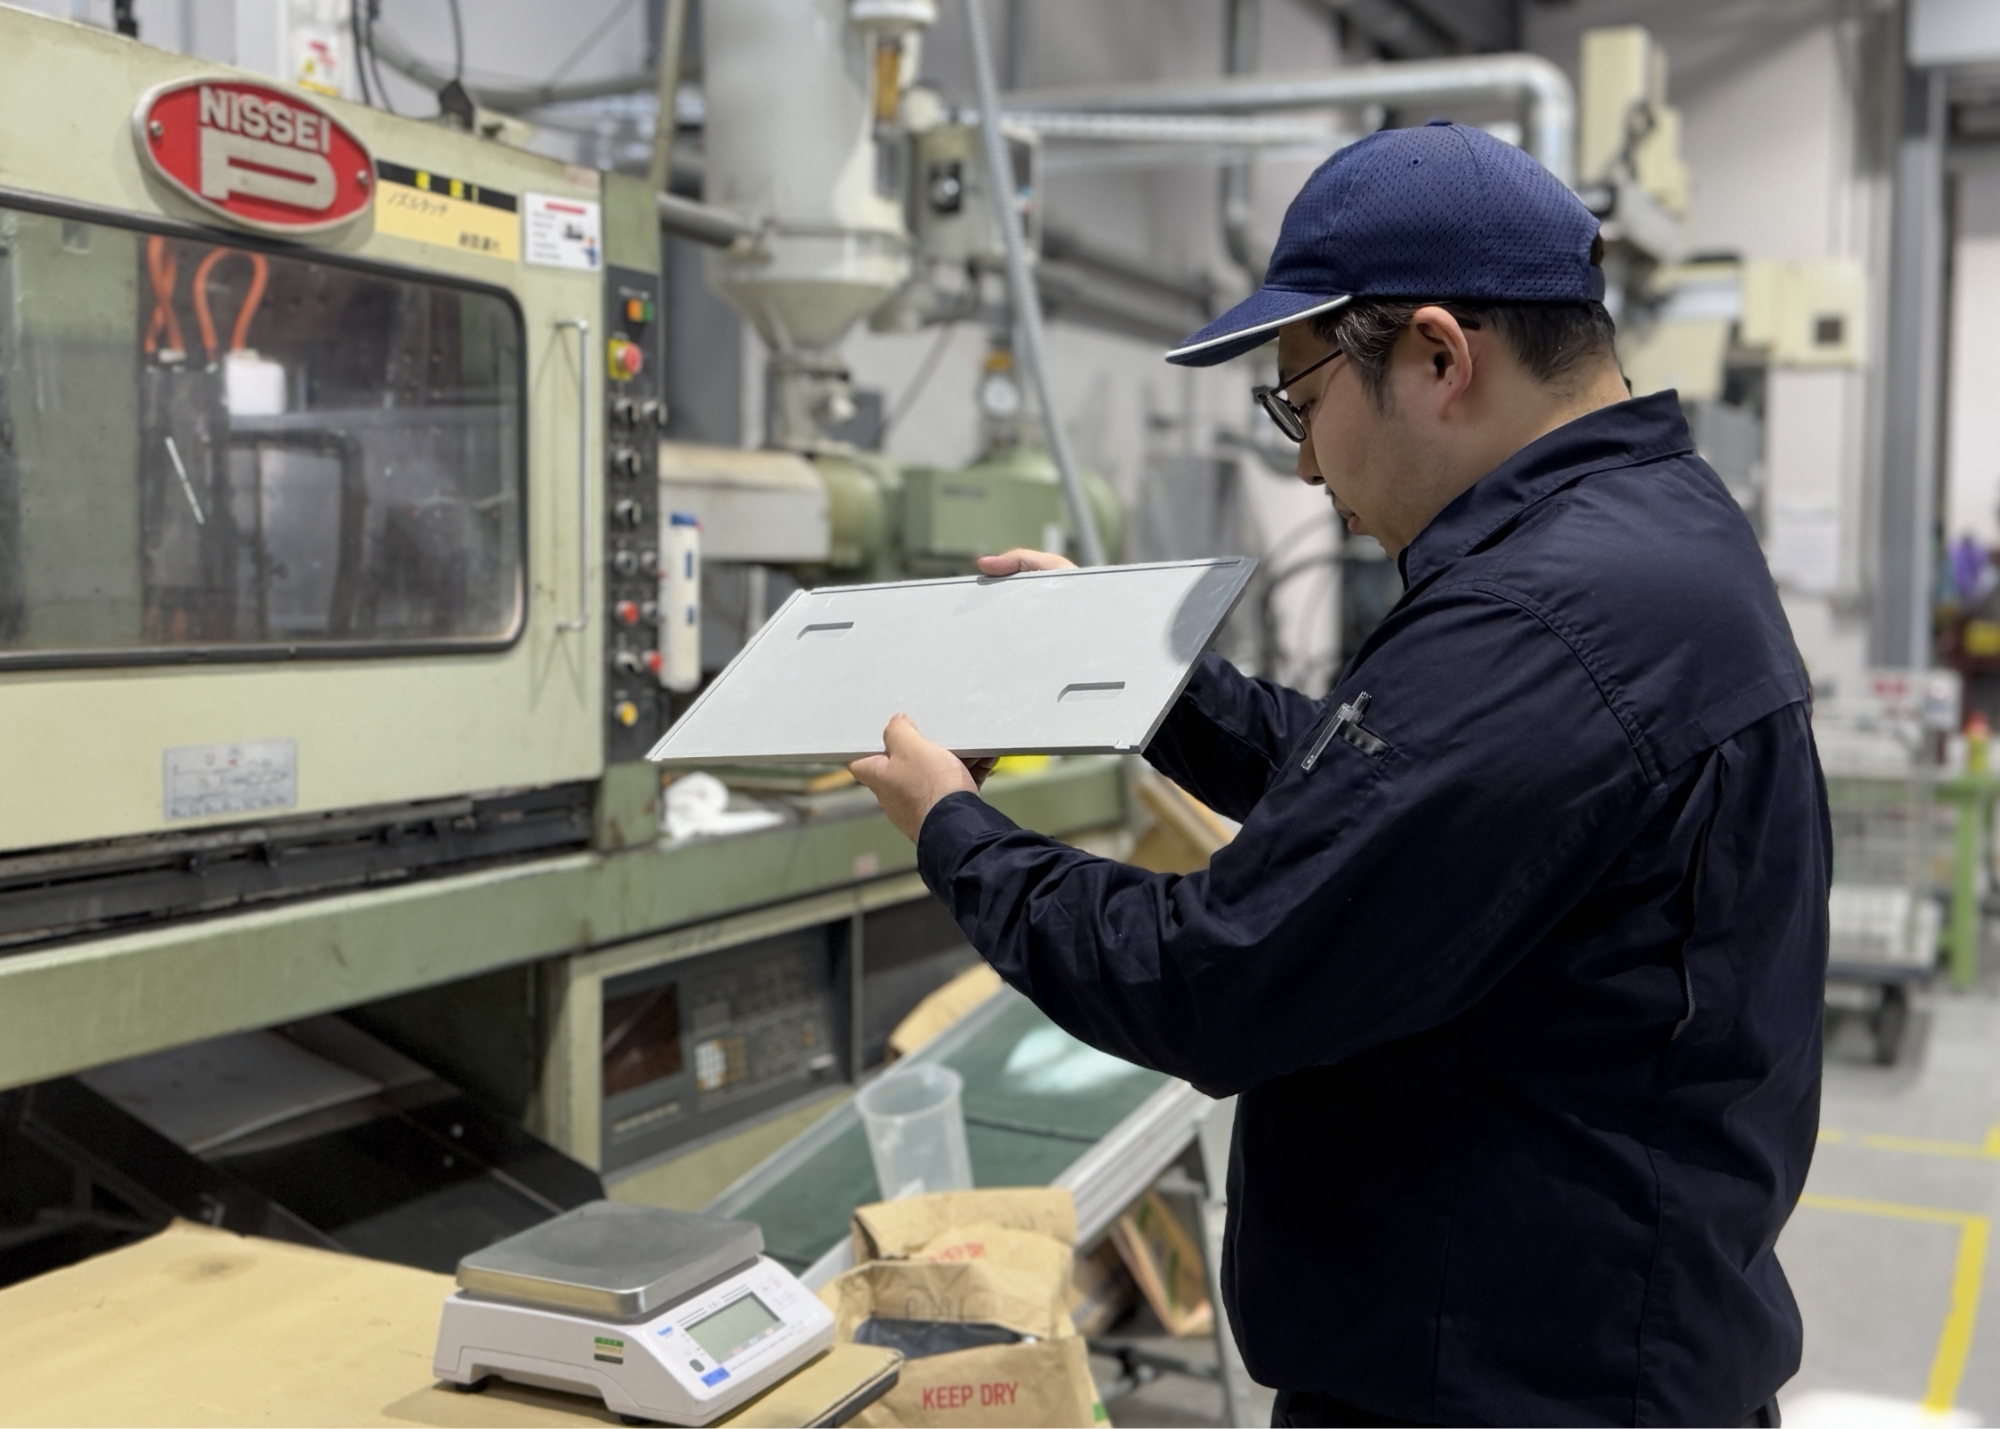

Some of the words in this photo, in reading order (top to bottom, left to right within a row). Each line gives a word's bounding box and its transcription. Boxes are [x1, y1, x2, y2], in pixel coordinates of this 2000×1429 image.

[200, 85, 331, 154] NISSEI
[922, 1384, 974, 1410] KEEP
[980, 1381, 1018, 1407] DRY
